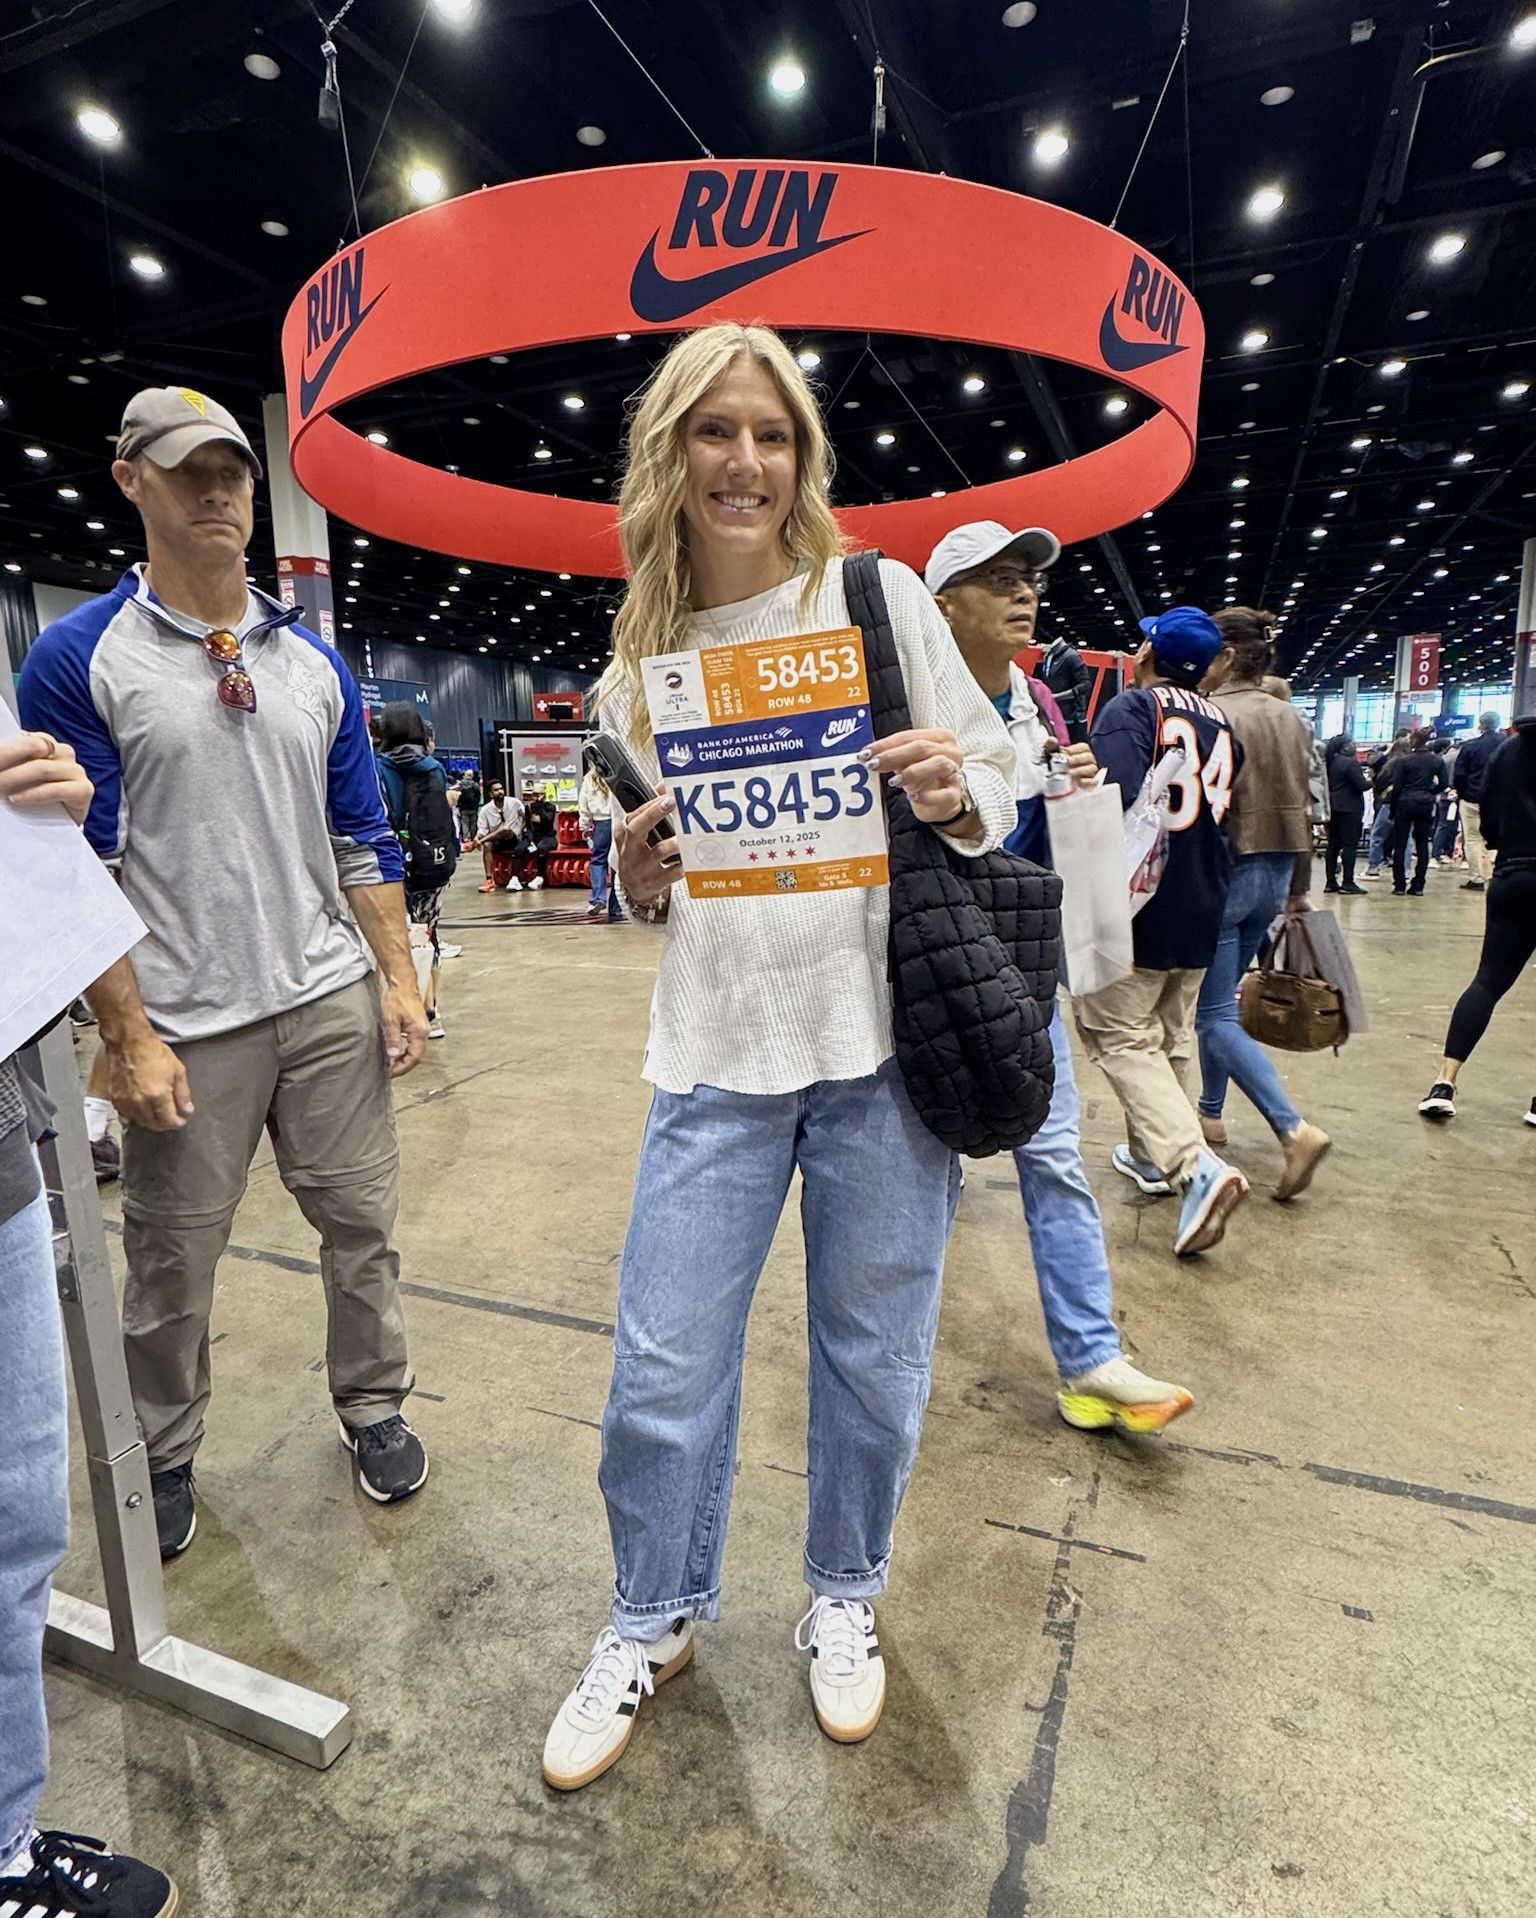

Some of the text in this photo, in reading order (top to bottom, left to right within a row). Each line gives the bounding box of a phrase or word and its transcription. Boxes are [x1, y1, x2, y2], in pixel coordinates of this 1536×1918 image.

[667, 168, 839, 249] RUN
[307, 248, 364, 357] RUN
[1121, 253, 1186, 345] RUN
[757, 645, 860, 692] 58453
[665, 696, 689, 705] ULTRA
[721, 682, 734, 715] 58453
[847, 686, 862, 697] 22
[713, 701, 722, 717] ROW
[735, 700, 743, 713] BOX
[768, 693, 812, 709] ROW 48
[827, 717, 857, 736] RUN
[697, 732, 775, 749] BANK OF AMERICA
[698, 738, 804, 762] CHICAGO MARATHON
[1160, 715, 1233, 832] 34
[673, 763, 874, 835] K58453
[739, 831, 820, 848] October 12, 2025
[859, 867, 873, 877] 22
[702, 879, 742, 889] ROW 48
